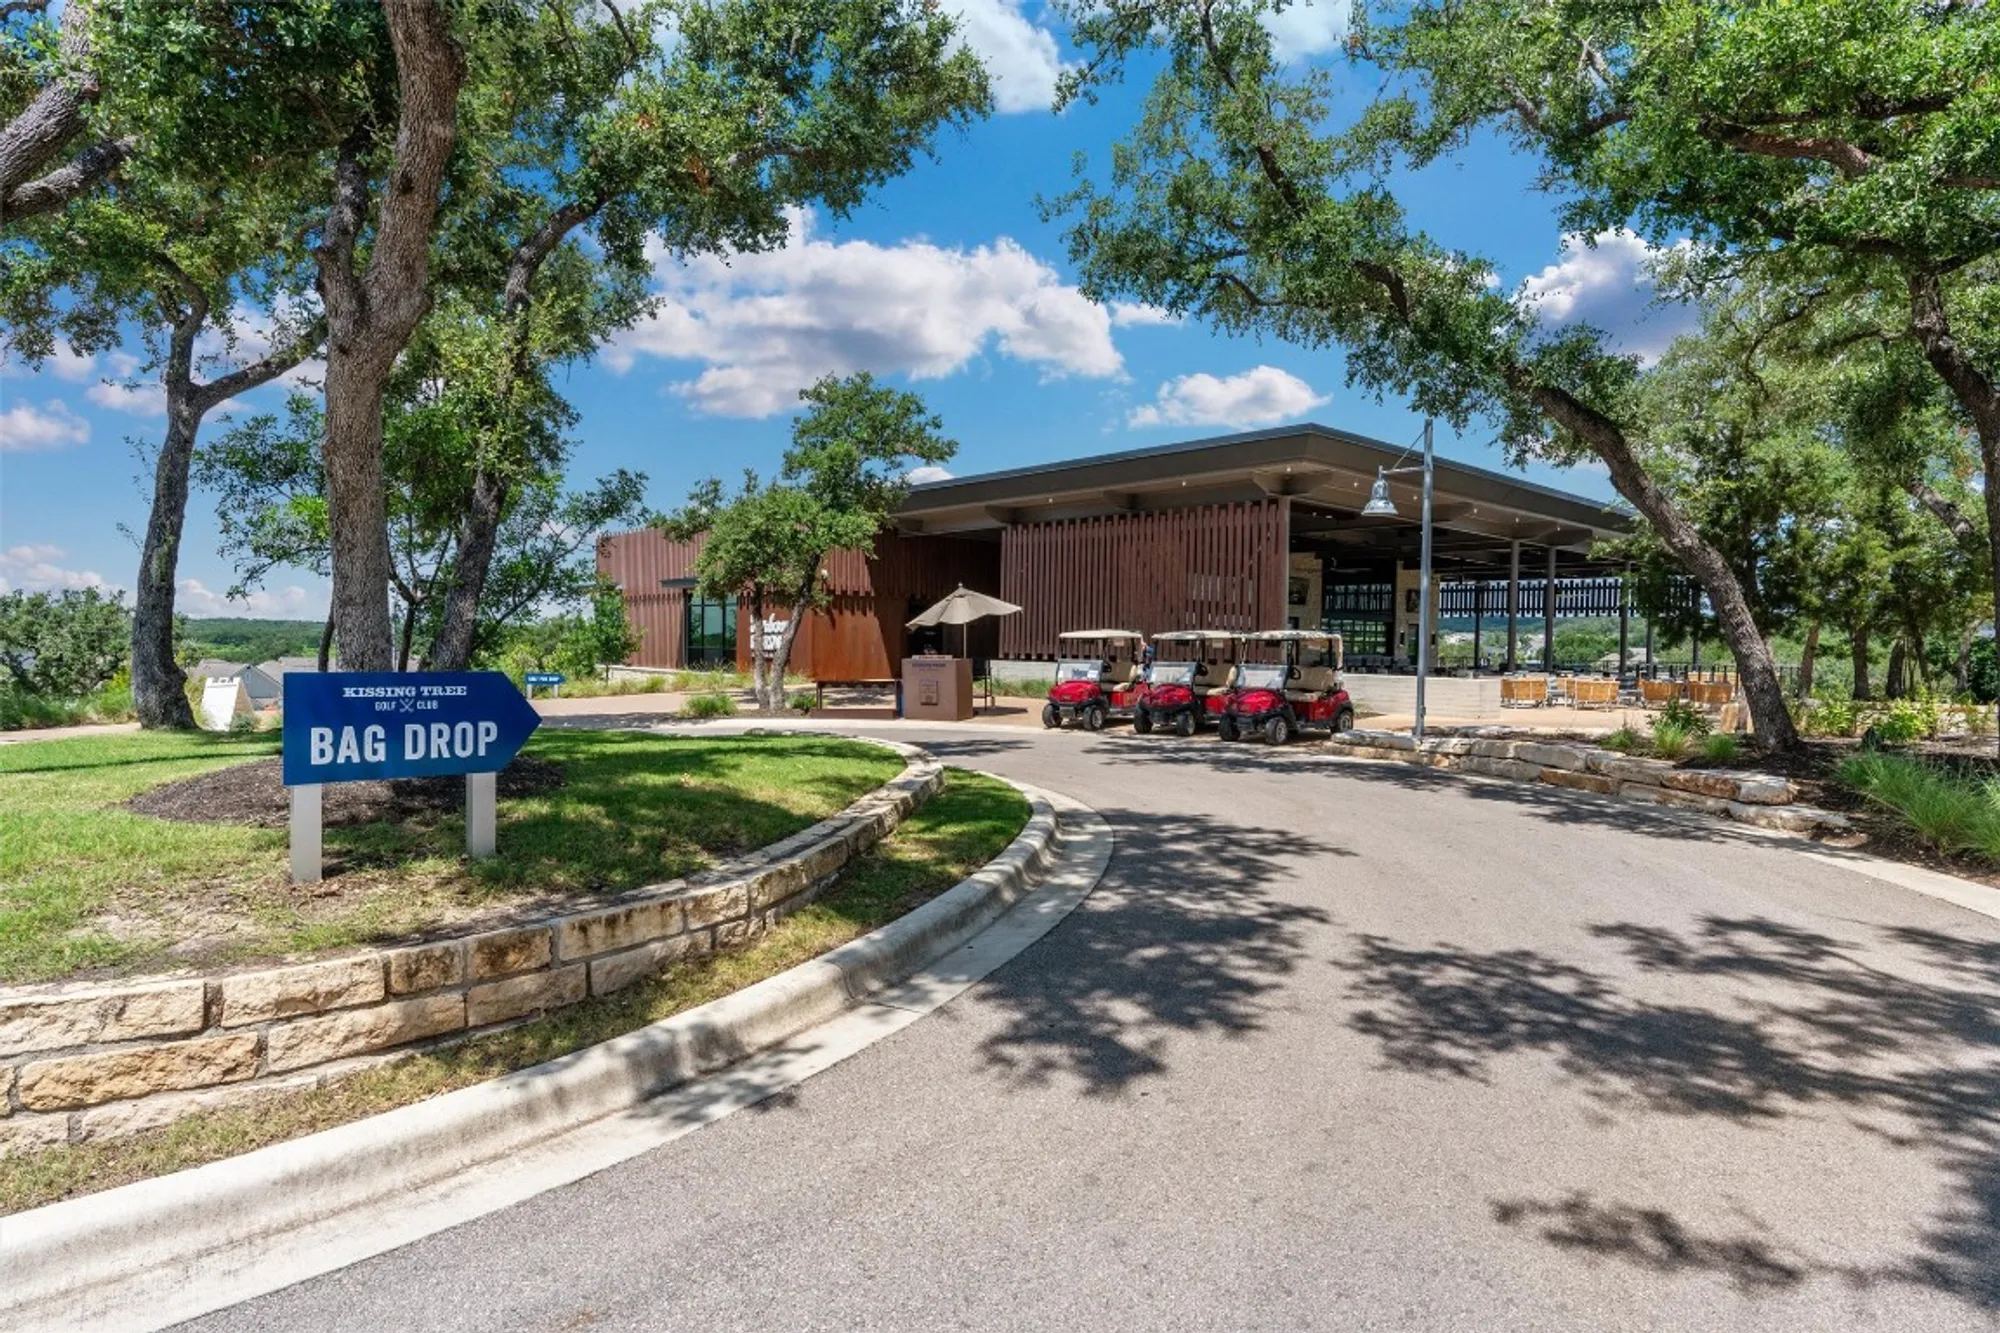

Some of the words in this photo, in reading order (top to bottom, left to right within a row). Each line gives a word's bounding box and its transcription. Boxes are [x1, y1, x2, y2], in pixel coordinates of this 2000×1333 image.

[343, 686, 416, 698] KISSING
[420, 686, 466, 696] TREE
[375, 702, 396, 711] GOLF
[417, 700, 438, 709] CLUB
[311, 725, 385, 765] BAG
[405, 722, 497, 759] DROP
